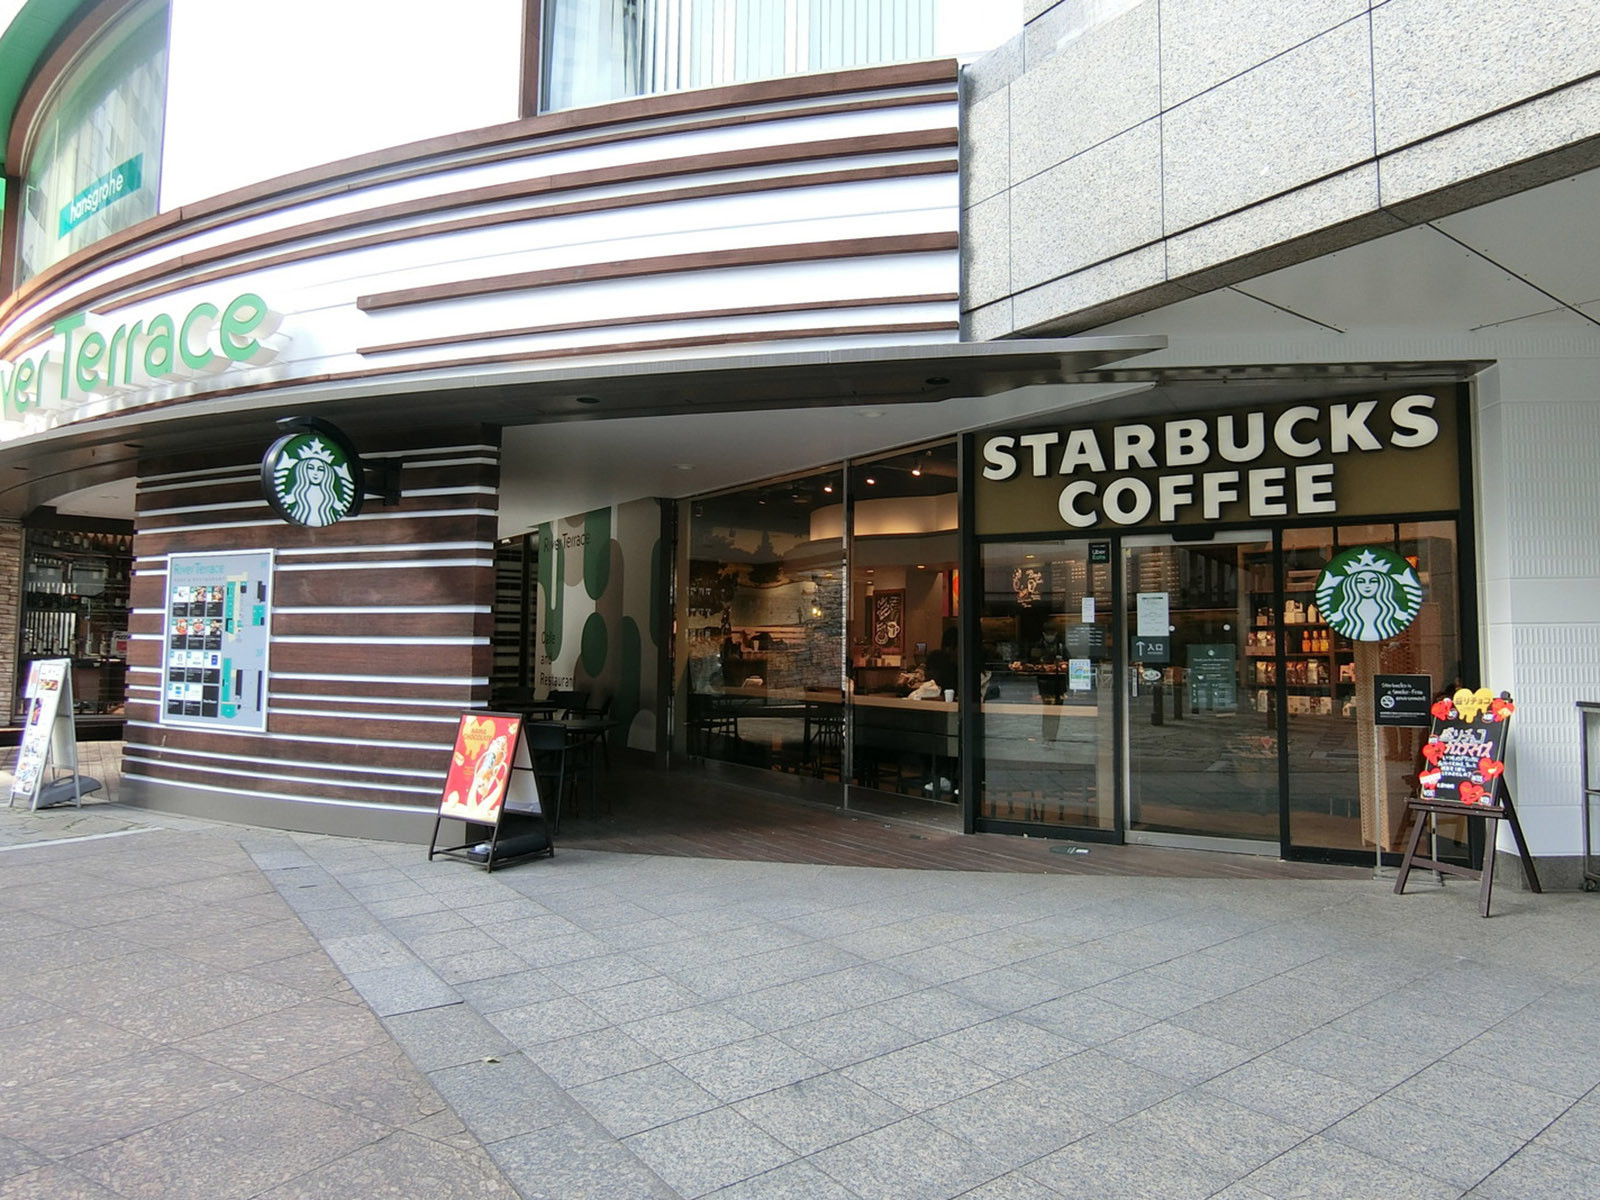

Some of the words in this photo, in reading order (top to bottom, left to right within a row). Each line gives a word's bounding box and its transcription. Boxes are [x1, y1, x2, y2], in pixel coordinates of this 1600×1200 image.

[70, 169, 124, 224] hansgrohe
[982, 394, 1439, 481] STARBUCKS
[1058, 463, 1337, 528] COFFEE
[1147, 643, 1163, 651] 入口
